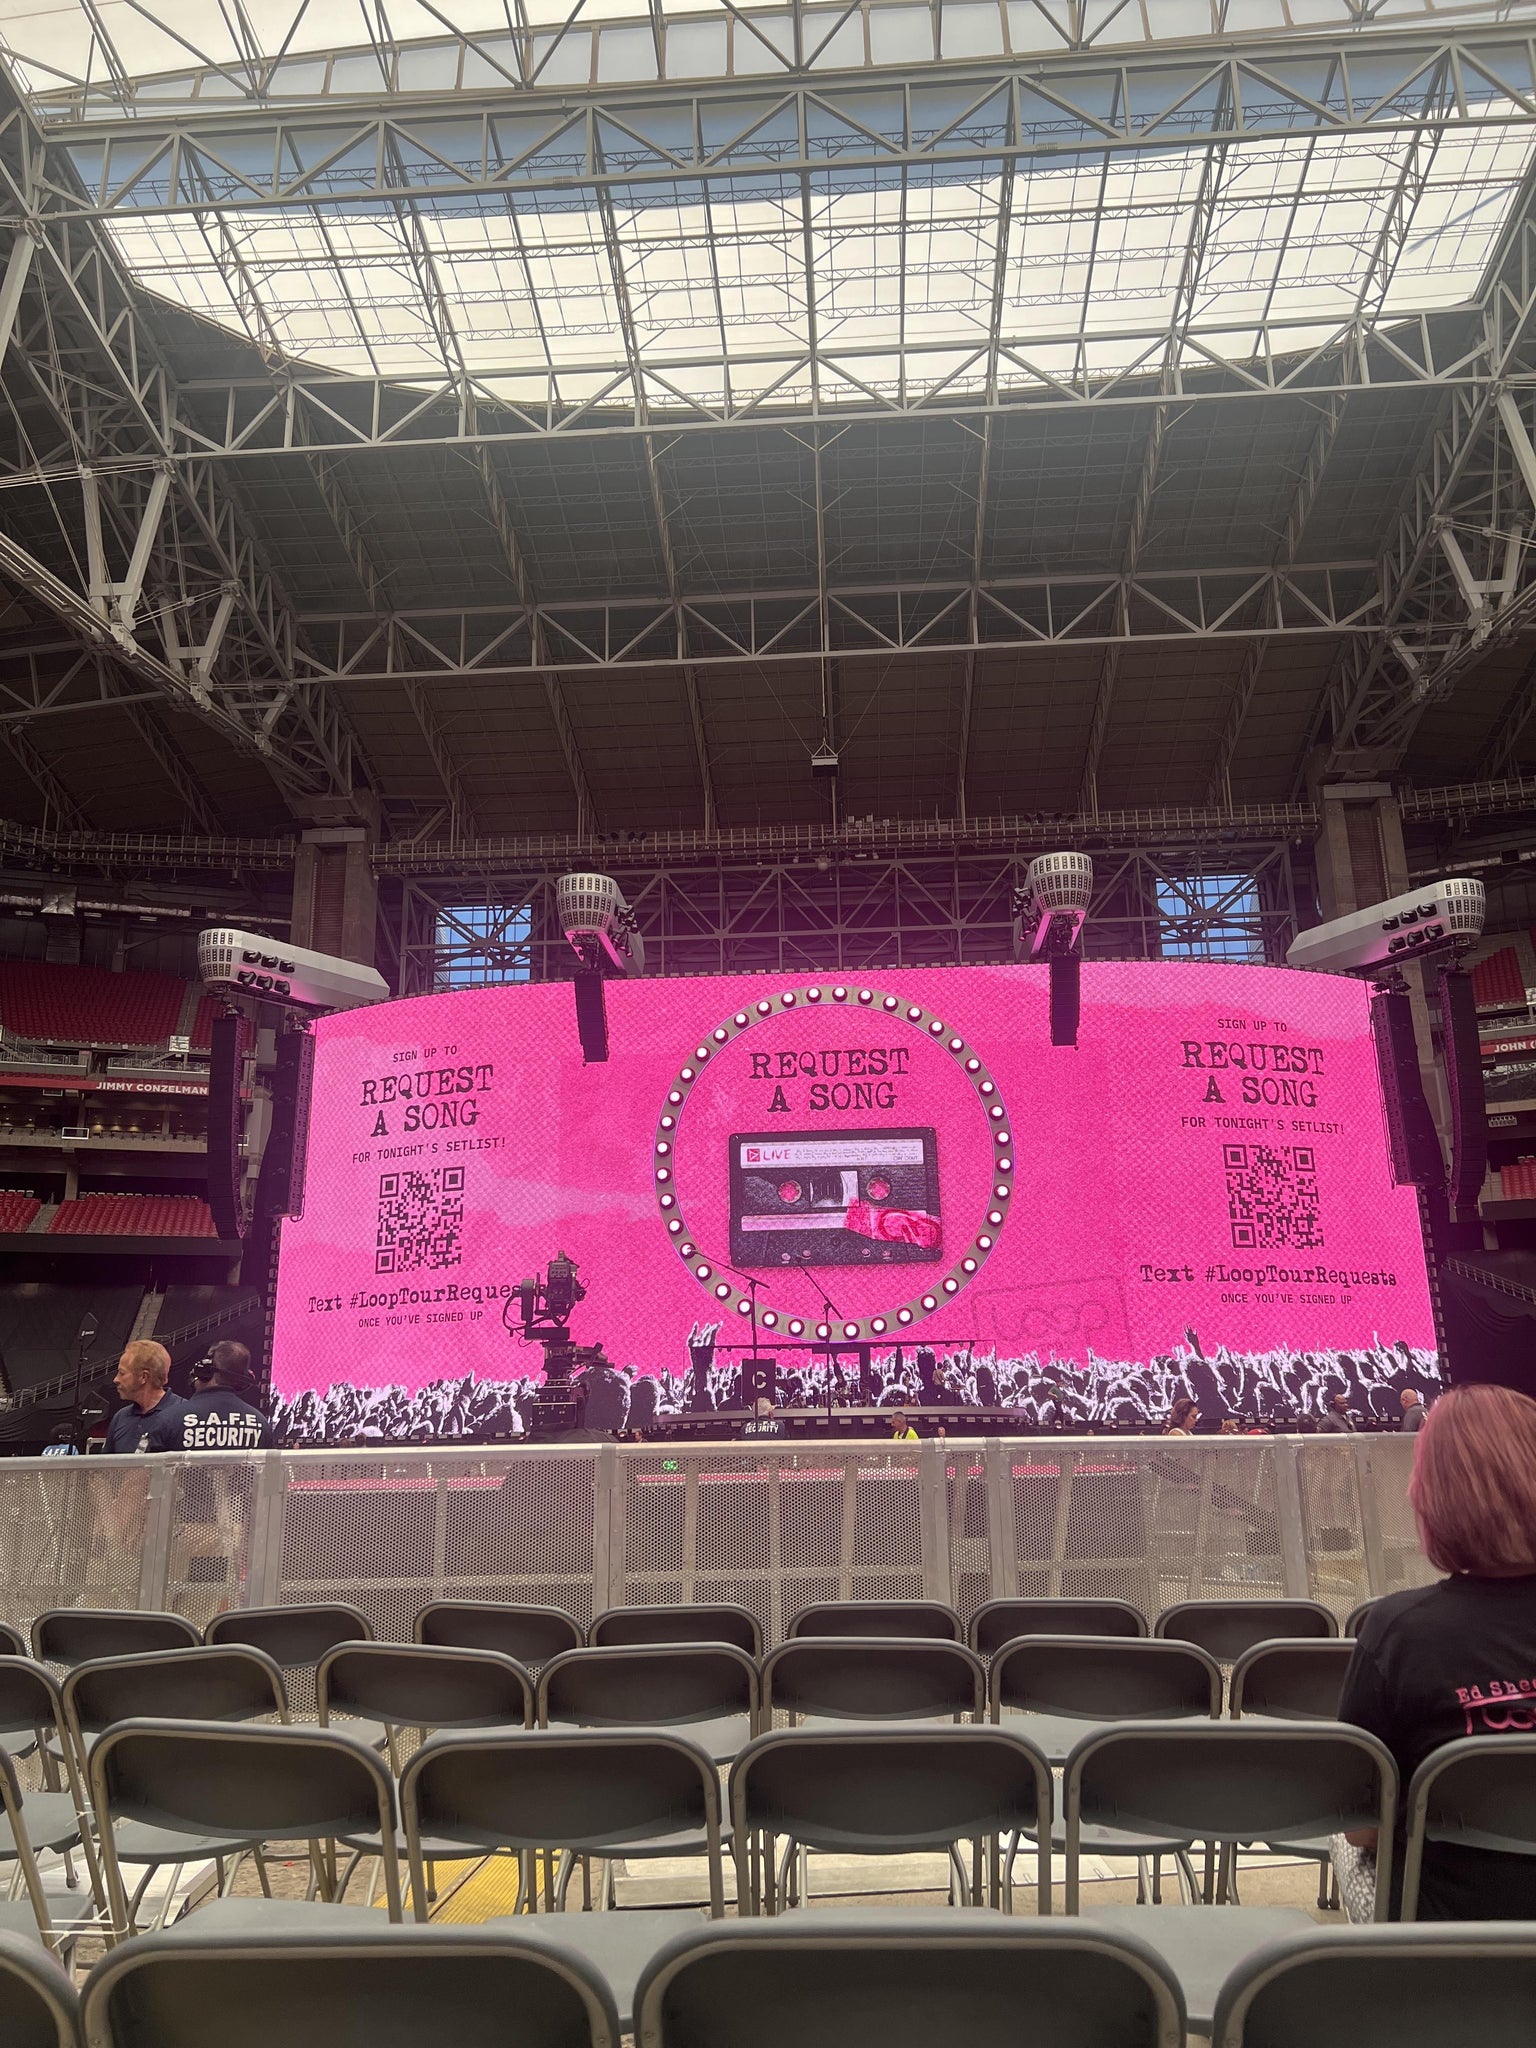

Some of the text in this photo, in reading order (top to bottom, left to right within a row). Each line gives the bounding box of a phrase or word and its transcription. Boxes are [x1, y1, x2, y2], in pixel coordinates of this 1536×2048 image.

[1217, 1018, 1288, 1033] SIGN UP TO
[392, 1045, 458, 1063] SIGN UP TO
[1494, 1041, 1527, 1053] JOHN
[748, 1048, 910, 1079] REQUEST
[1179, 1040, 1325, 1075] REQUEST
[96, 1081, 208, 1095] JIMMY CONZELMAN
[360, 1064, 494, 1106] REQUEST
[1202, 1075, 1319, 1108] A SONG
[766, 1082, 898, 1112] A SONG
[370, 1099, 481, 1138] A SONG
[1181, 1116, 1345, 1135] FOR TONIGHT'S SETLIST!
[352, 1136, 507, 1164] FOR TONIGHT'S SETLIST!
[763, 1149, 791, 1161] LIVE
[1140, 1264, 1397, 1289] Text #LoopTourRequests
[308, 1283, 530, 1314] Text #LoopTourReque
[1220, 1293, 1249, 1304] ONCE
[1299, 1294, 1336, 1305] SIGNED
[1340, 1295, 1352, 1305] UP
[358, 1317, 381, 1328] ONCE
[426, 1312, 463, 1324] SIGNED
[470, 1311, 484, 1321] UP
[184, 1412, 262, 1427] S.A.F.E.
[183, 1427, 262, 1447] SECURITY
[1455, 1684, 1484, 1704] Ed
